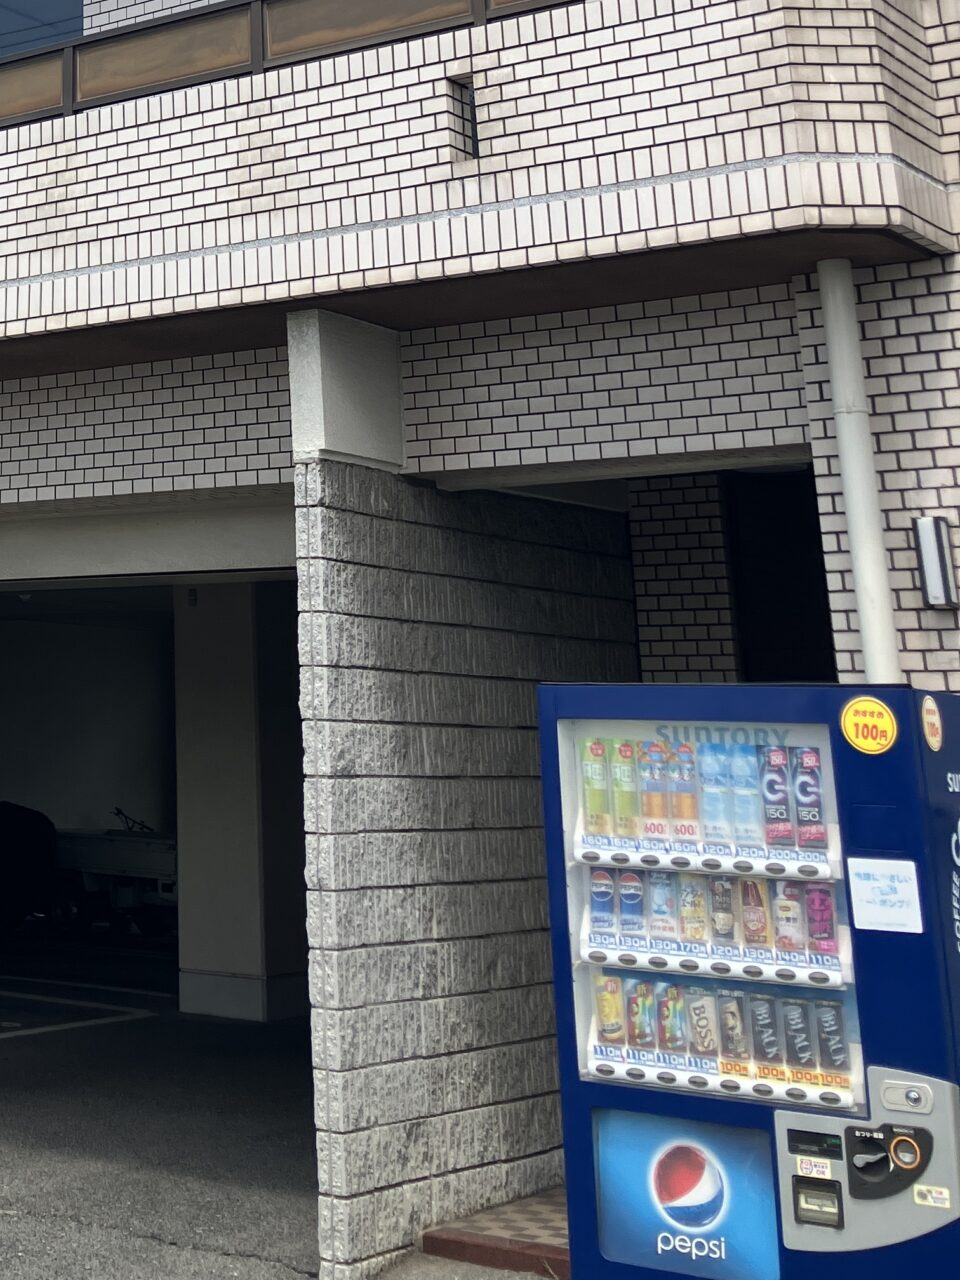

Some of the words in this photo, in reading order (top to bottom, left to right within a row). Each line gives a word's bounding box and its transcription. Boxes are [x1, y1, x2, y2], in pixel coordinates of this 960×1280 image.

[853, 722, 888, 741] 100円
[692, 1004, 715, 1049] BOSS
[755, 1007, 778, 1058] BLACK
[787, 1011, 813, 1063] BLACK
[821, 1012, 847, 1066] BLACK
[657, 1232, 726, 1260] pepsi
